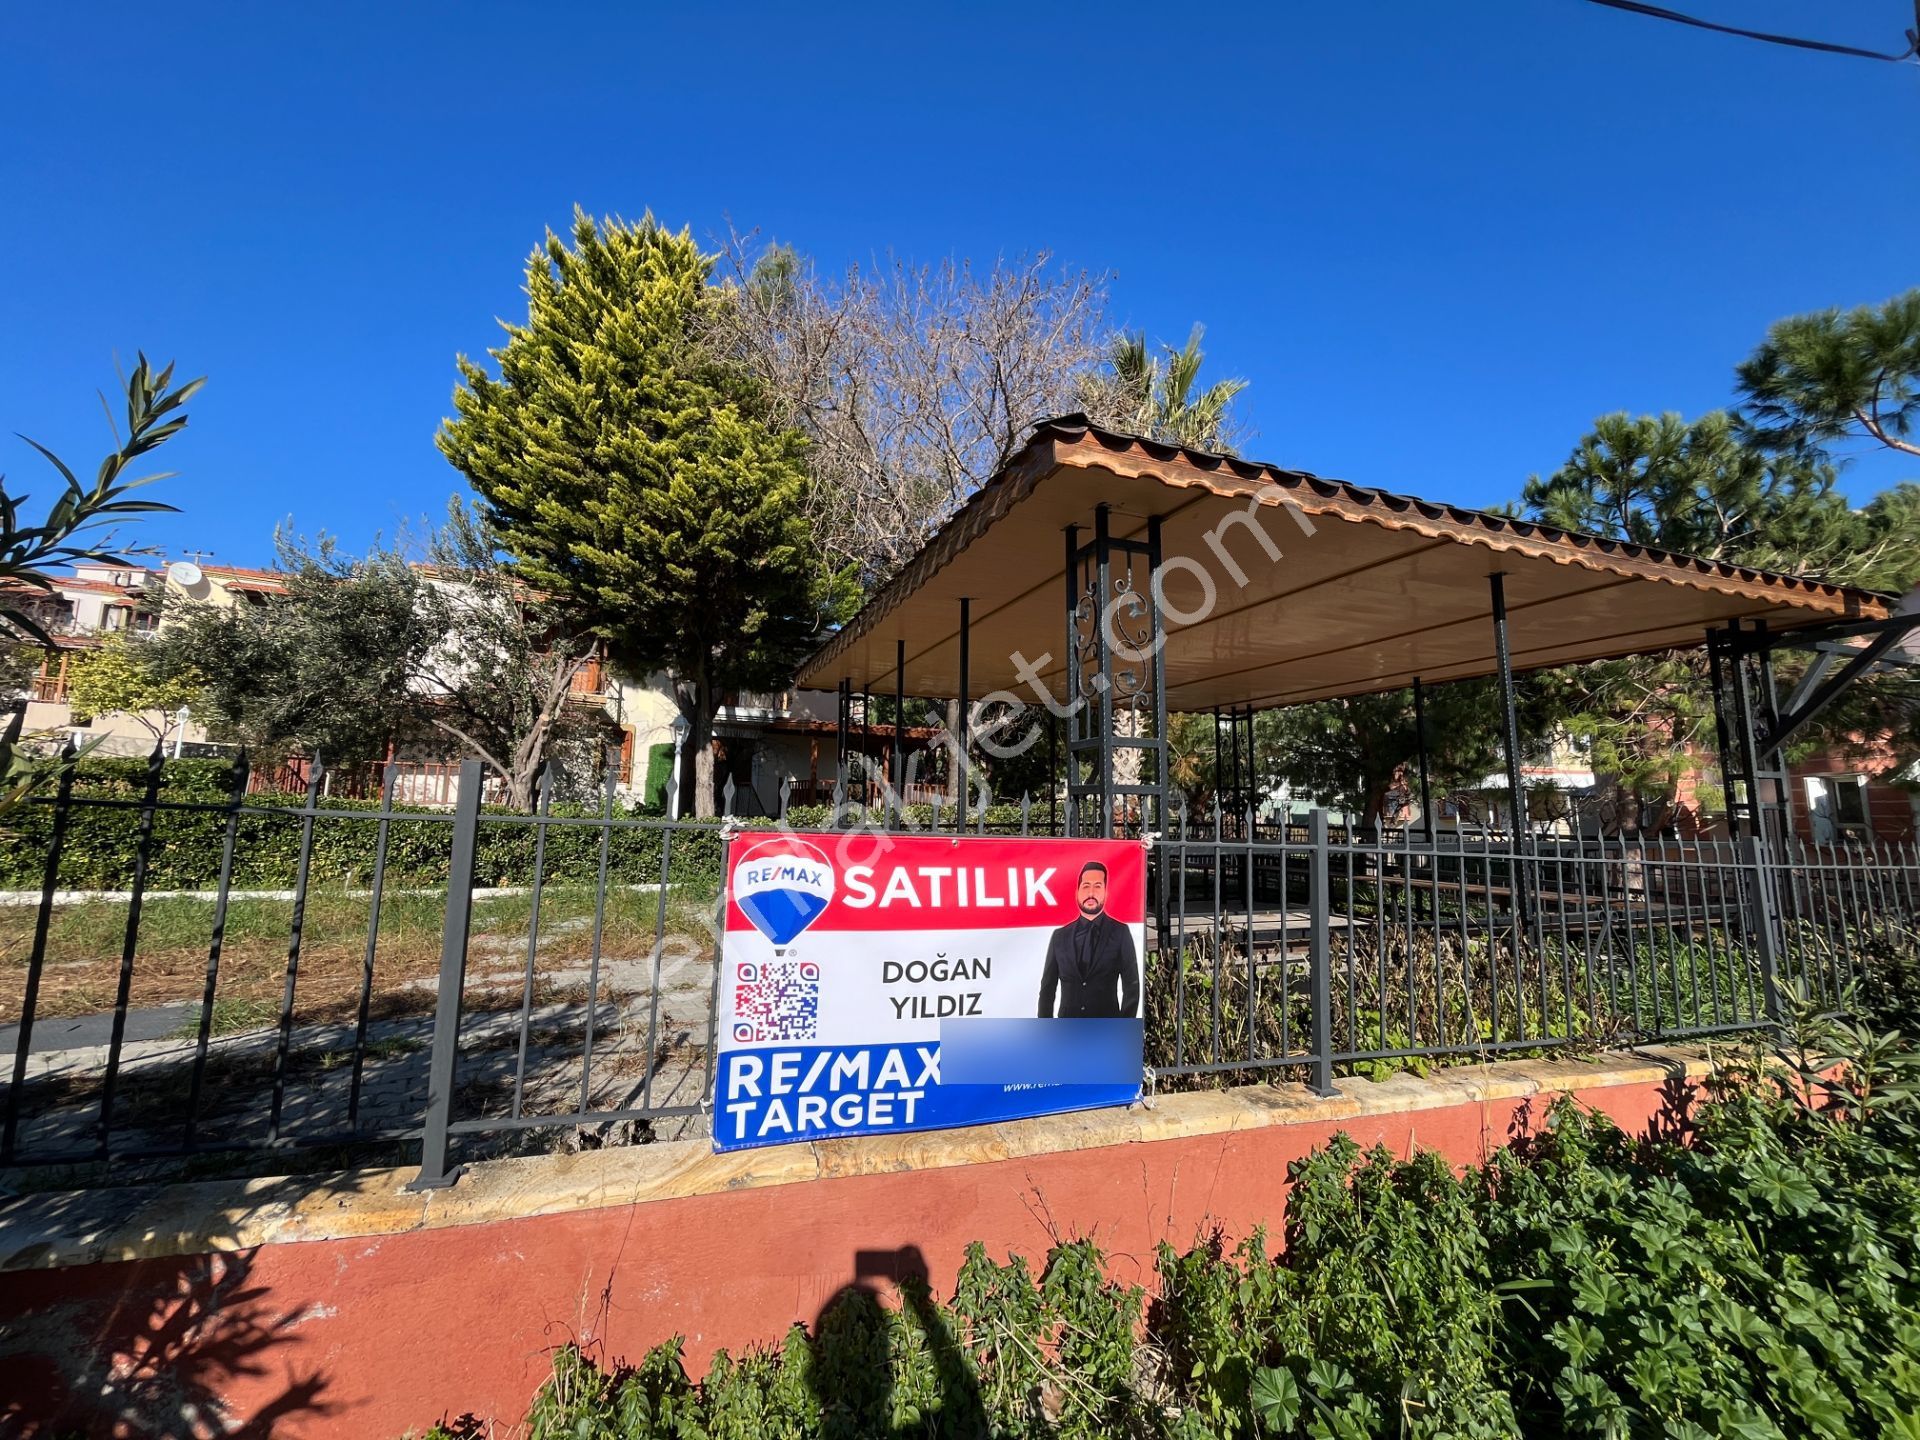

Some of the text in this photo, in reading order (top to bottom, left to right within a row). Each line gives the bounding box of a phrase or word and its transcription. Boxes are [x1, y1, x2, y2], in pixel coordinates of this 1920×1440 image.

[747, 866, 823, 887] RE/MAX
[842, 865, 1058, 908] SATILIK
[882, 952, 991, 984] DOĞAN
[889, 992, 983, 1020] YILDIZ
[728, 1047, 941, 1100] RE/MAX
[726, 1090, 925, 1140] TARGET
